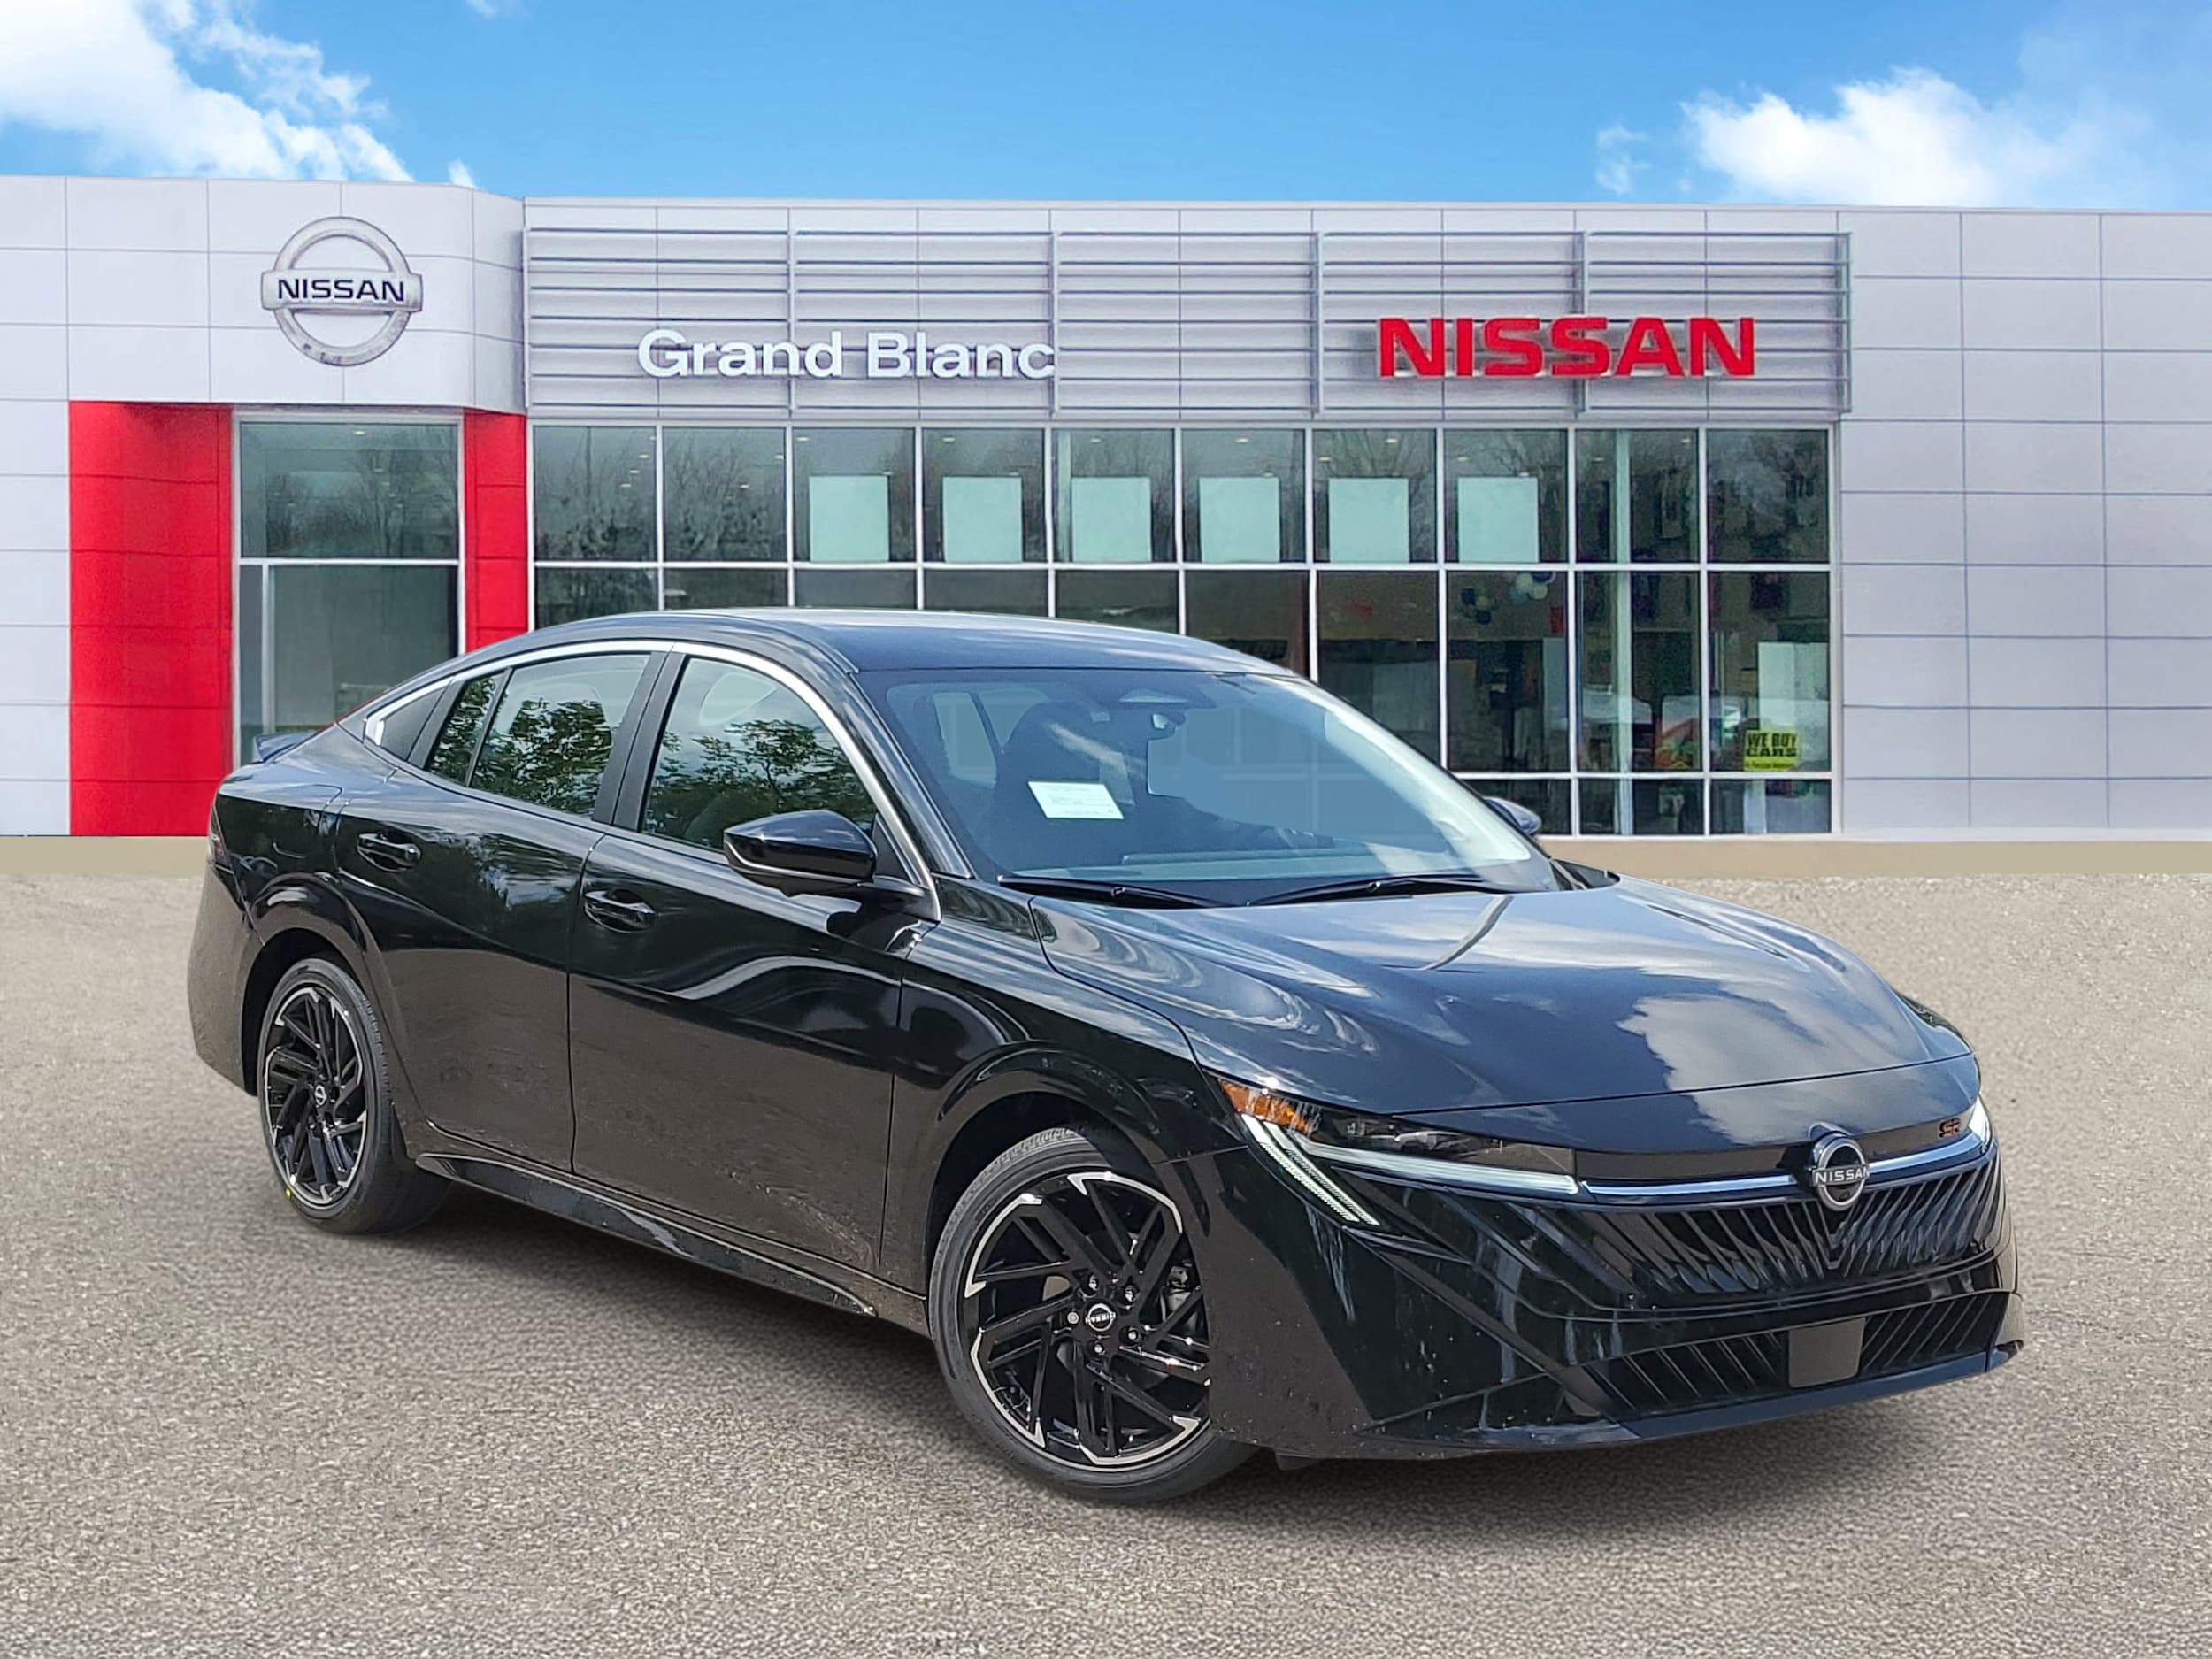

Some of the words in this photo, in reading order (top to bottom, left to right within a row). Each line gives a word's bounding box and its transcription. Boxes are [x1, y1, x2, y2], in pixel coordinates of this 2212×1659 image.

[278, 278, 405, 302] NISSAN
[638, 328, 841, 379] Grand
[867, 330, 1056, 380] Blanc
[1379, 316, 1755, 378] NISSAN
[1747, 732, 1768, 747] WE
[1771, 732, 1797, 747] BUY
[1746, 747, 1797, 757] CARS
[1815, 1166, 1870, 1185] NISSAN
